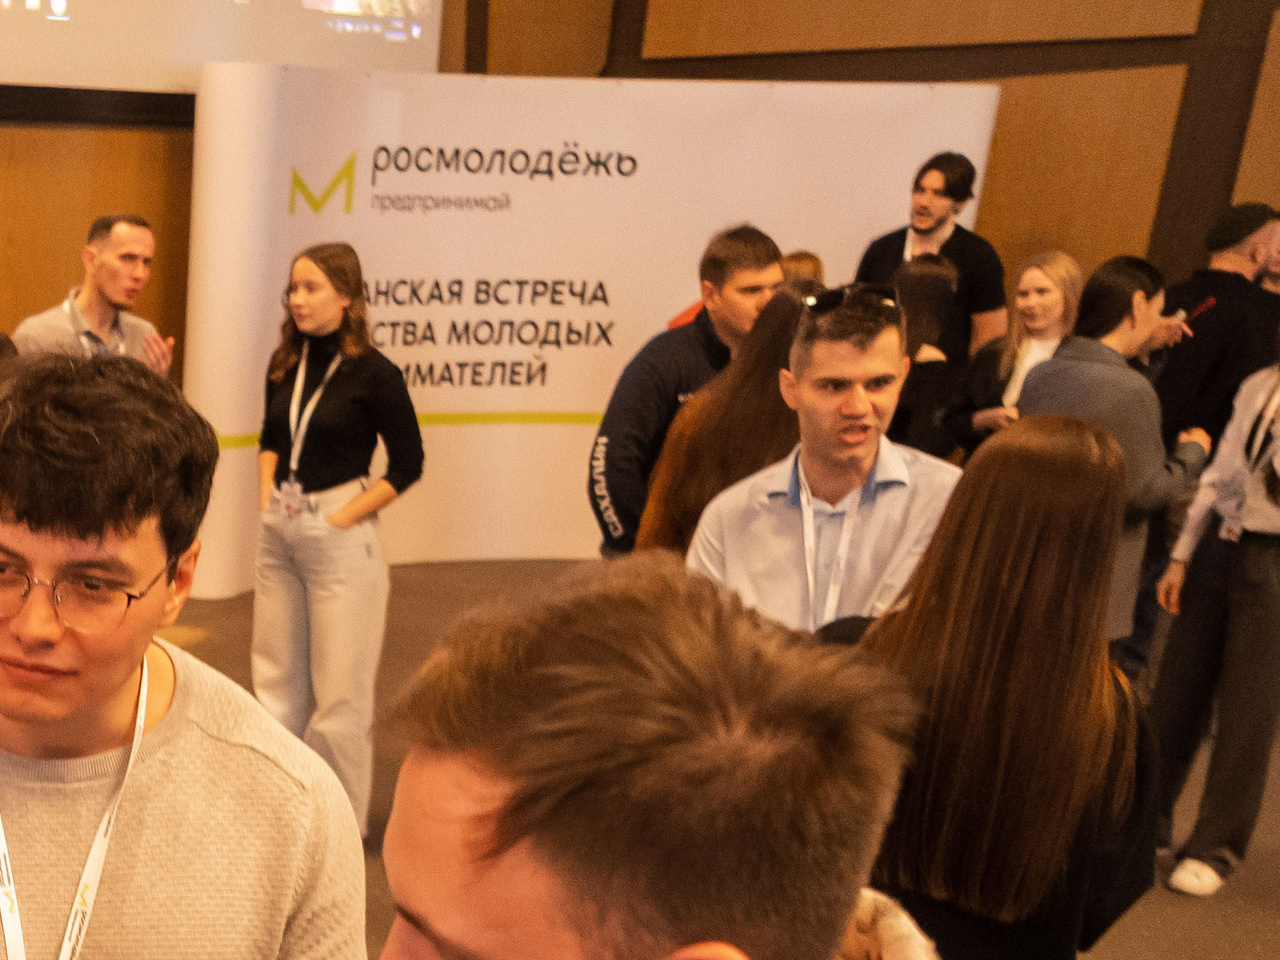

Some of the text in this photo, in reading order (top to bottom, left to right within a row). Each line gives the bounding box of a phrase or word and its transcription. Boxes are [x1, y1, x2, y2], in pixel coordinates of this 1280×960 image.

[371, 142, 638, 187] росмолодёжь
[475, 280, 610, 307] ВСТРЕЧА
[371, 320, 614, 349] СТВА МОЛОДЫХ
